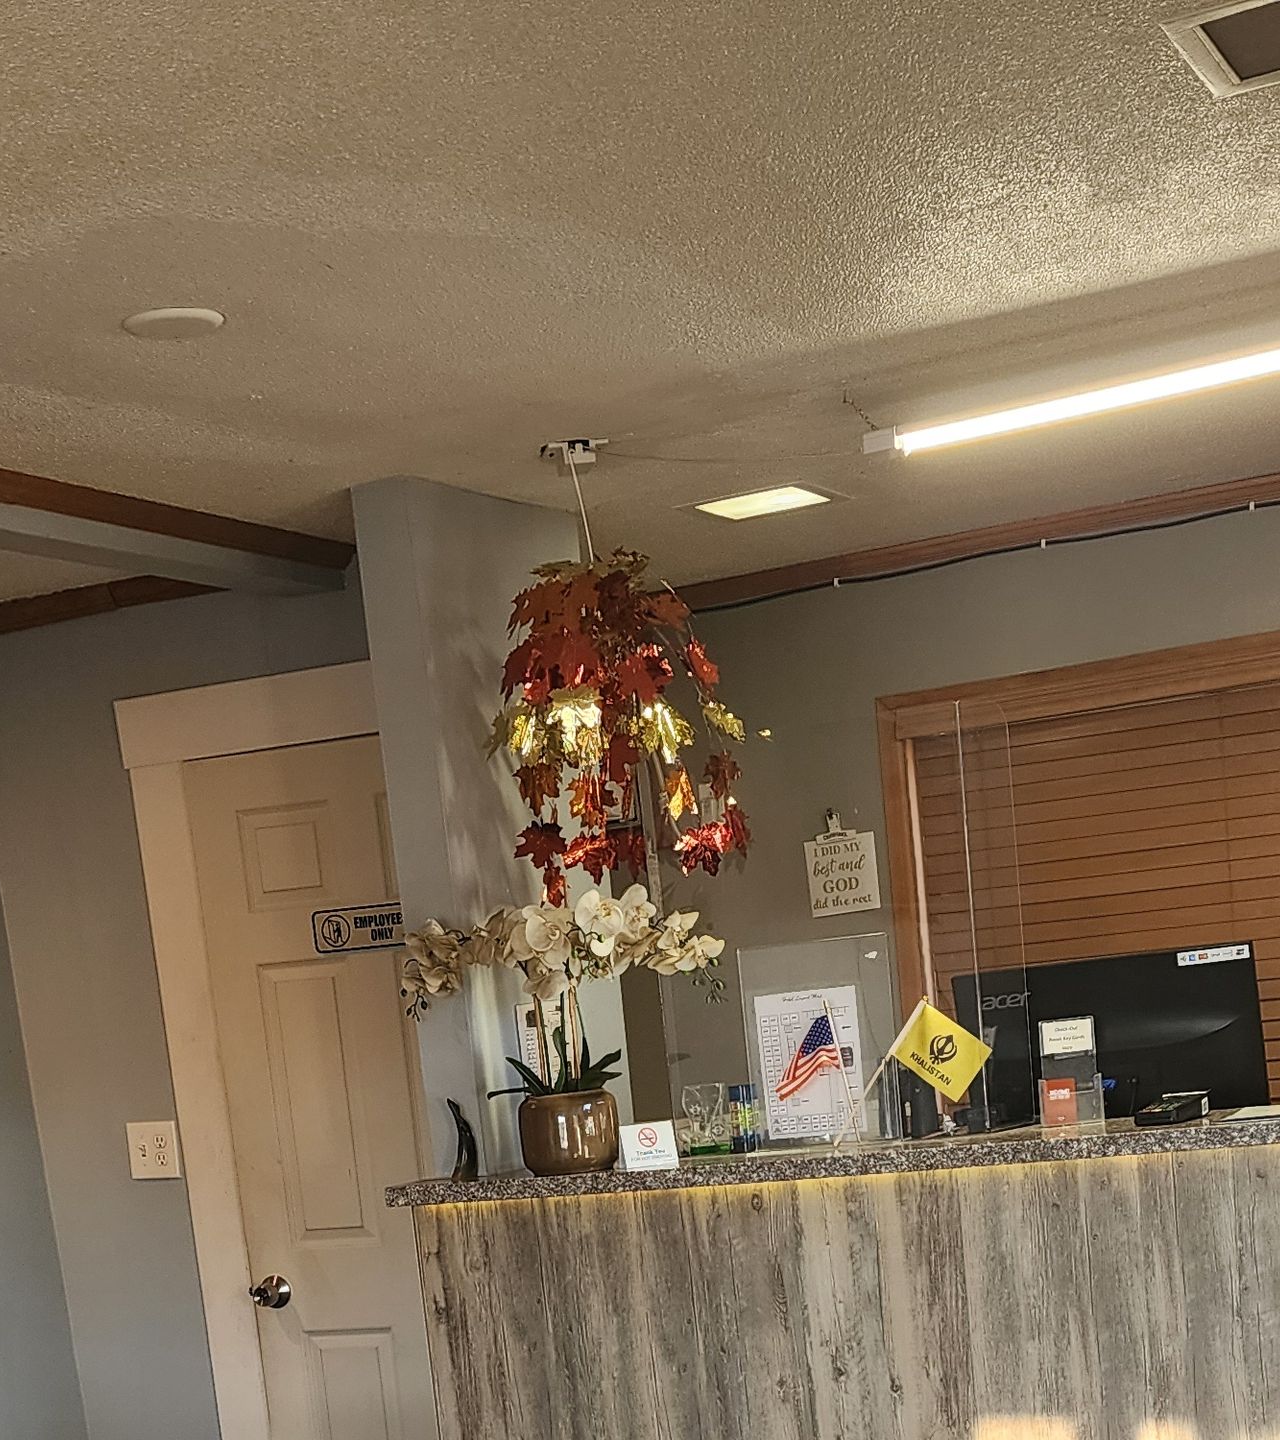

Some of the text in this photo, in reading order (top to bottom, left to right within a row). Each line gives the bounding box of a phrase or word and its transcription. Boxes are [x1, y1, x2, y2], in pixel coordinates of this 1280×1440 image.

[813, 841, 862, 858] I DID MY
[813, 853, 866, 878] best and
[823, 876, 859, 894] GOD
[813, 896, 829, 910] did
[832, 895, 849, 907] the
[353, 911, 404, 929] EMPLOYEE
[370, 926, 394, 942] ONLY
[981, 991, 1032, 1011] acer
[909, 1051, 953, 1087] KHALISTAN
